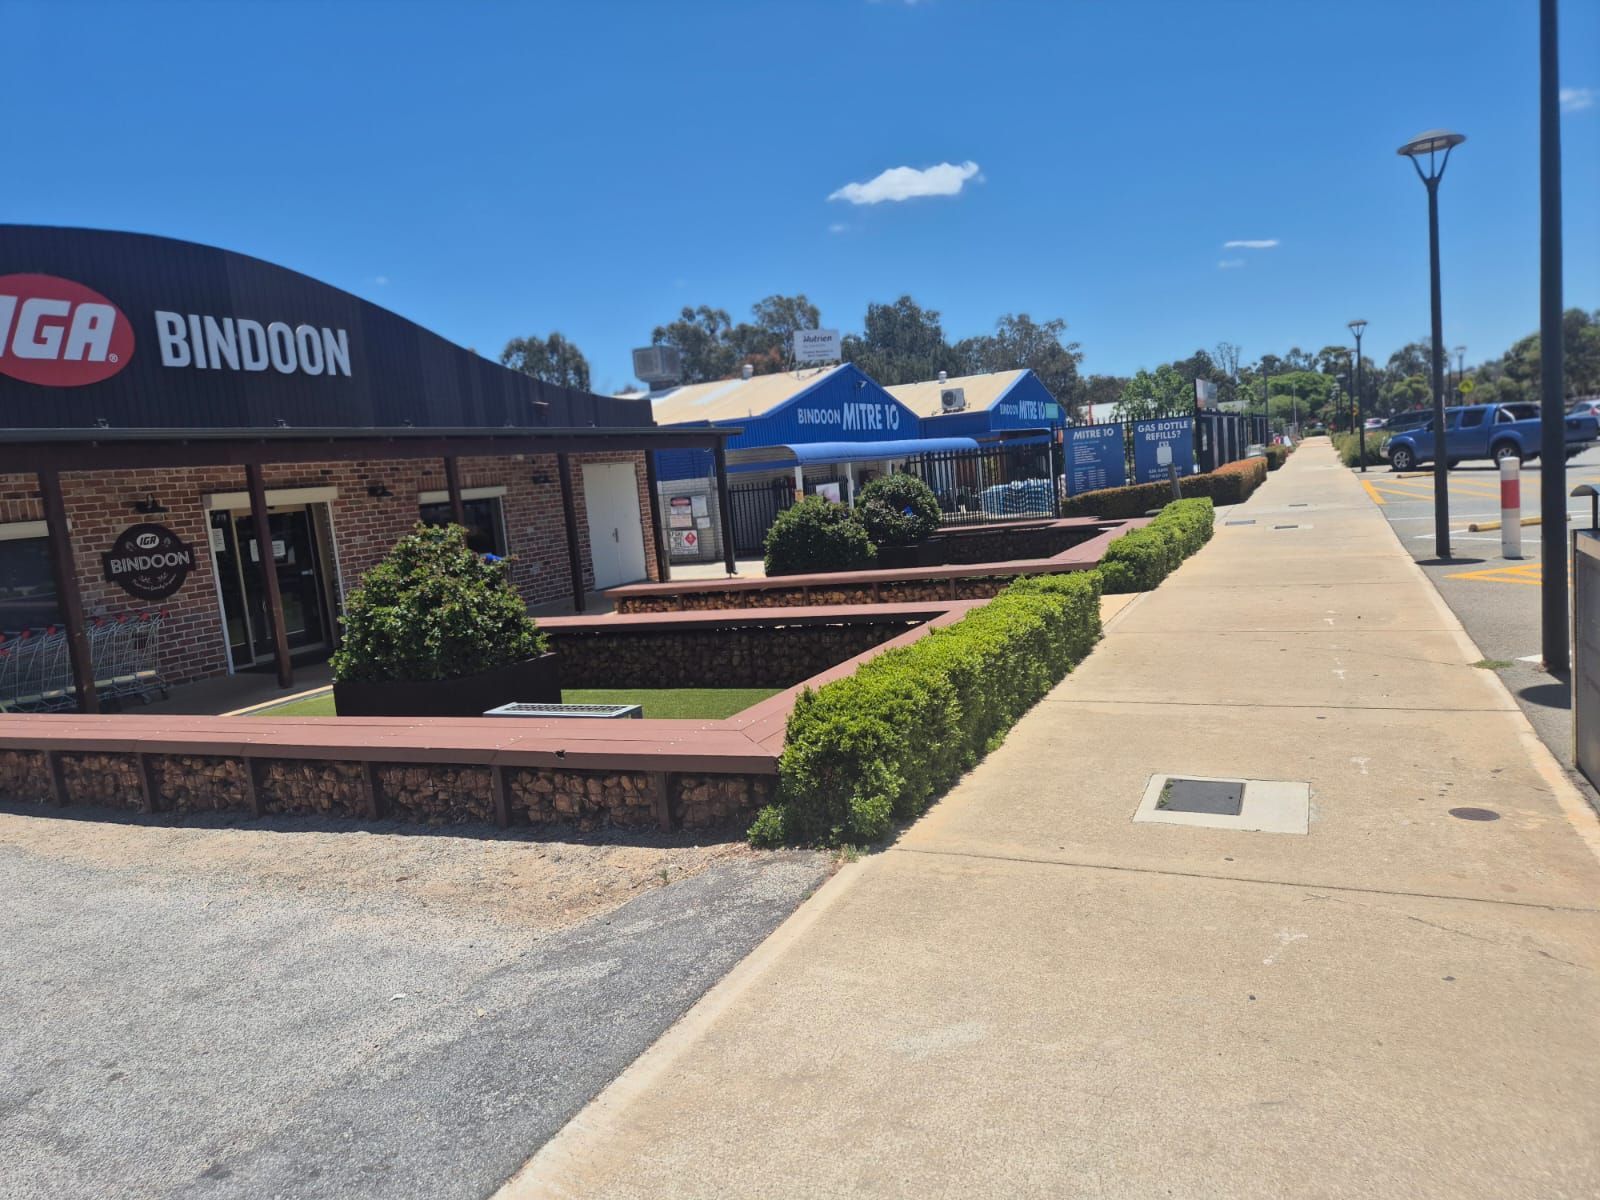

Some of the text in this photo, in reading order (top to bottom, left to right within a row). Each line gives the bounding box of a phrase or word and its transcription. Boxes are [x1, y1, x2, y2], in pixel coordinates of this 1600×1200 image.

[155, 310, 351, 377] BINDOON
[803, 335, 833, 343] Nutrien
[797, 402, 899, 431] BINDOON MITRE 10
[1019, 400, 1037, 420] MITRE
[1138, 420, 1189, 433] GAS BOTTLE
[1073, 428, 1114, 440] MITRE 10
[1145, 430, 1181, 441] REFILLS?
[140, 536, 157, 545] IGA
[110, 551, 190, 574] BINDOON
